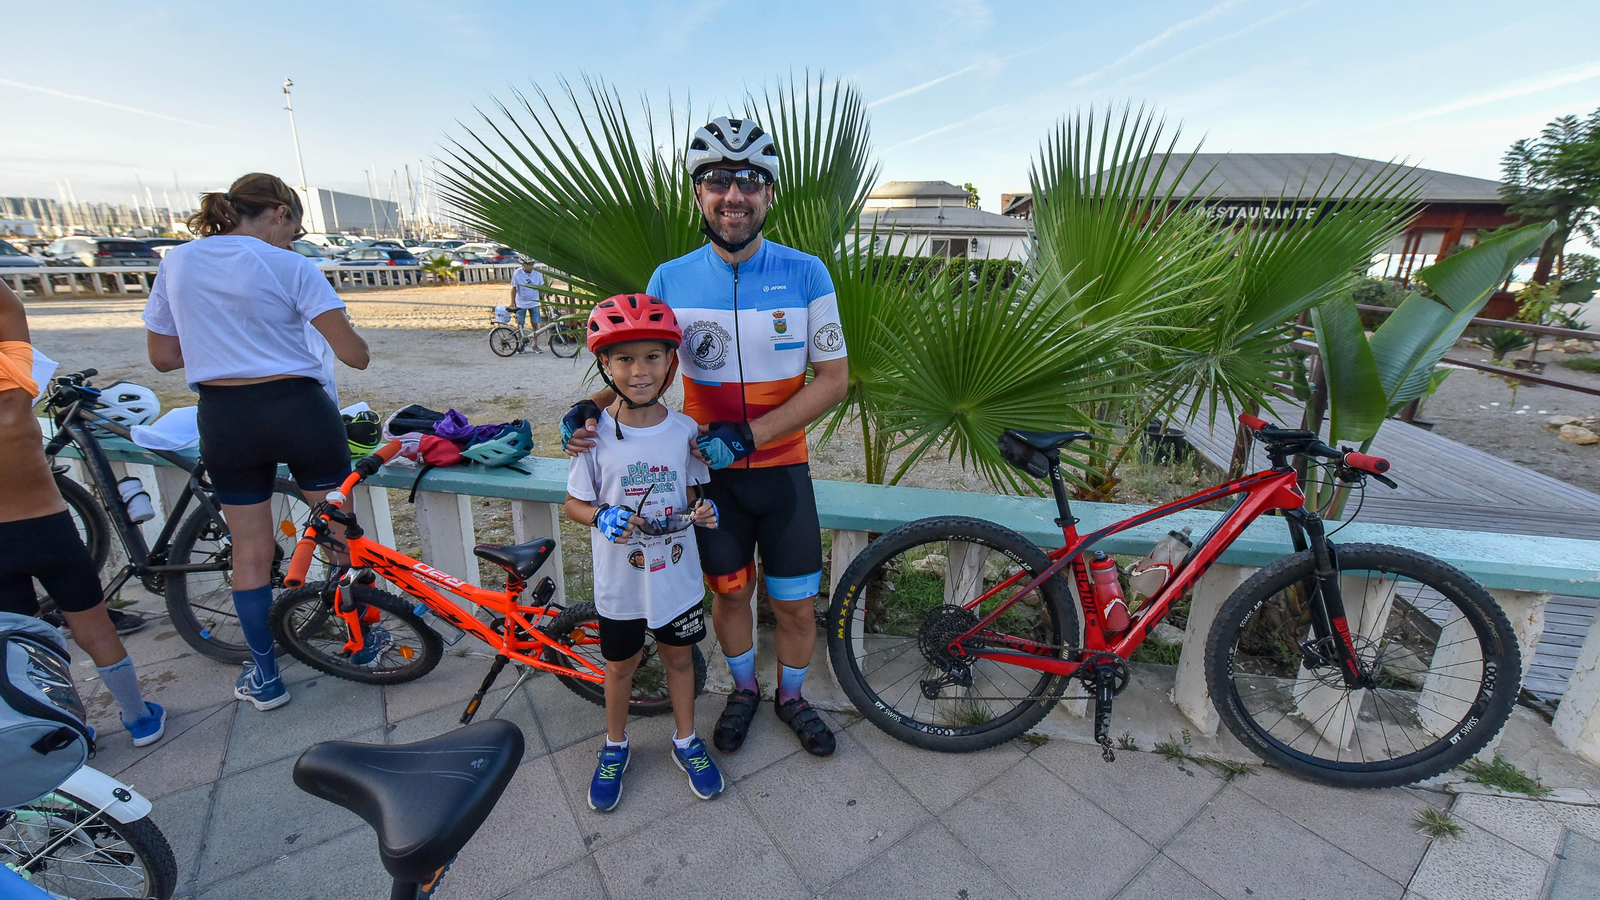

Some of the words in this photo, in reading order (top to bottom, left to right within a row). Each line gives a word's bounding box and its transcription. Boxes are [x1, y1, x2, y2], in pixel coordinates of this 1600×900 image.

[1195, 205, 1318, 220] RESTAURANTE
[627, 461, 649, 475] DÍA
[620, 471, 677, 487] BICICLETA
[652, 482, 676, 494] 2021
[838, 585, 856, 639] MAXXIS
[874, 701, 886, 710] DT
[883, 708, 902, 723] SWISS
[1226, 694, 1269, 749] CONTINENTAL
[1449, 732, 1462, 745] DT
[1460, 715, 1479, 736] SWISS
